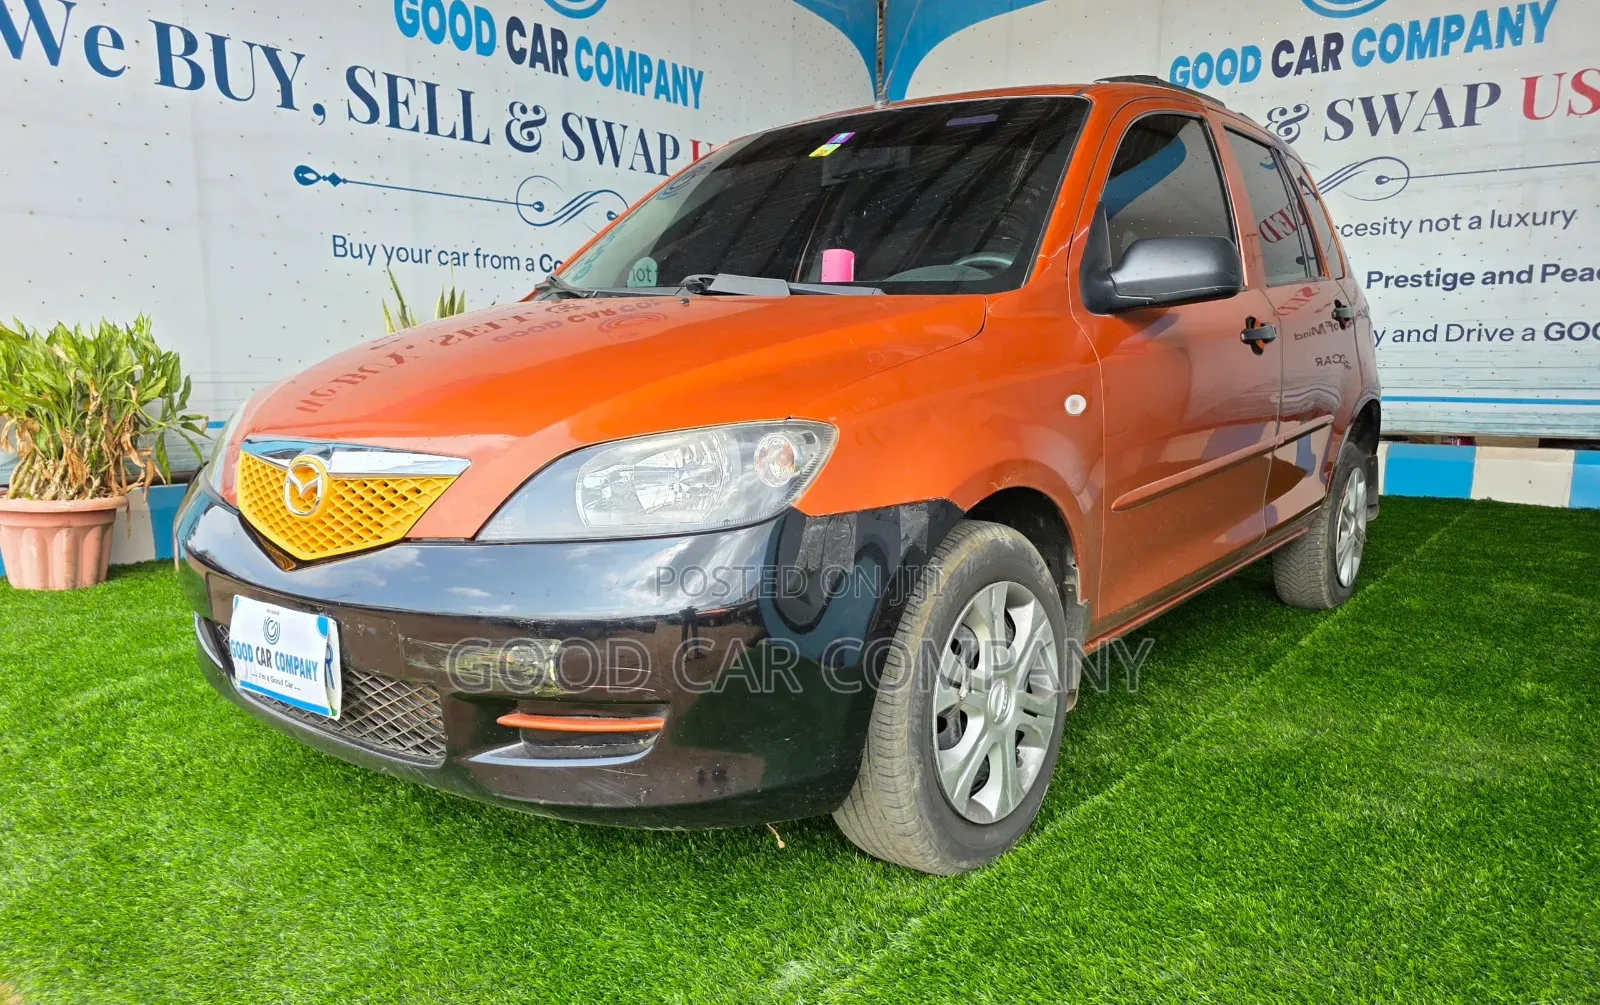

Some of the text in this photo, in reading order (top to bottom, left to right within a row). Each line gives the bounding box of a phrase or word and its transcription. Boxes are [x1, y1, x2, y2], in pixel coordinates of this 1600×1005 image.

[394, 0, 704, 110] GOOD CAR COMPANY
[1169, 0, 1558, 90] GOOD CAR COMPANY
[0, 0, 127, 78] We
[148, 19, 326, 126] BUY,
[345, 65, 491, 146] SELL
[505, 101, 547, 153] &
[561, 111, 681, 177] SWAP
[1264, 68, 1600, 145] & SWAP US
[1335, 209, 1578, 239] cesity not a luxury
[332, 234, 378, 267] Buy
[381, 243, 432, 267] your
[437, 247, 470, 268] car
[474, 248, 521, 271] from
[525, 257, 535, 272] a
[1366, 263, 1600, 292] Prestige and Pea
[1391, 323, 1439, 343] and
[1445, 322, 1515, 342] Drive
[1521, 327, 1536, 342] a
[230, 639, 318, 682] GOOD CAR COMPANY
[271, 675, 285, 686] Good
[285, 680, 294, 689] Car
